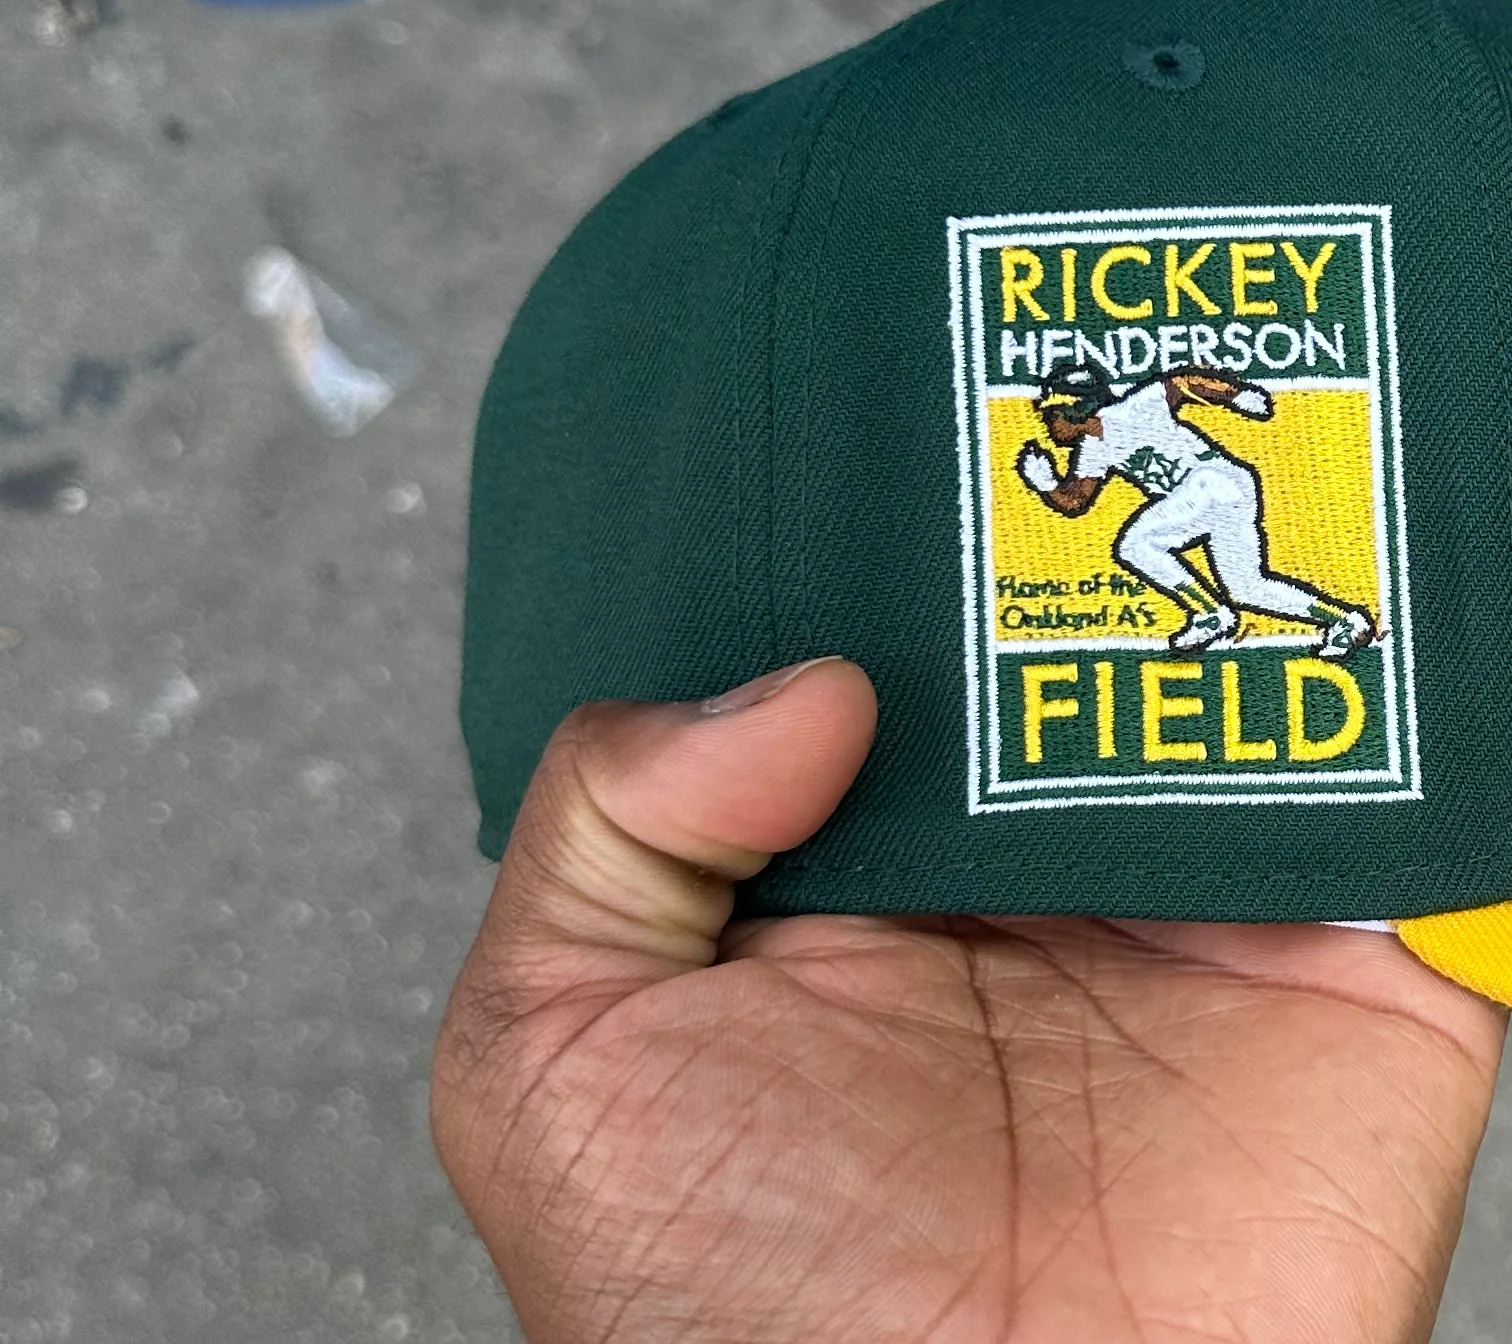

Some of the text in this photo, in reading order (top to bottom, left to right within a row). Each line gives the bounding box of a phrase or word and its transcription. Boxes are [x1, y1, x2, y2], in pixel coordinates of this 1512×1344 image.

[999, 241, 1337, 322] RICKEY
[1000, 319, 1347, 380] HENDERSON
[996, 571, 1147, 598] Home of the
[1001, 601, 1158, 631] Oakland A's
[1020, 658, 1366, 765] FIELD
